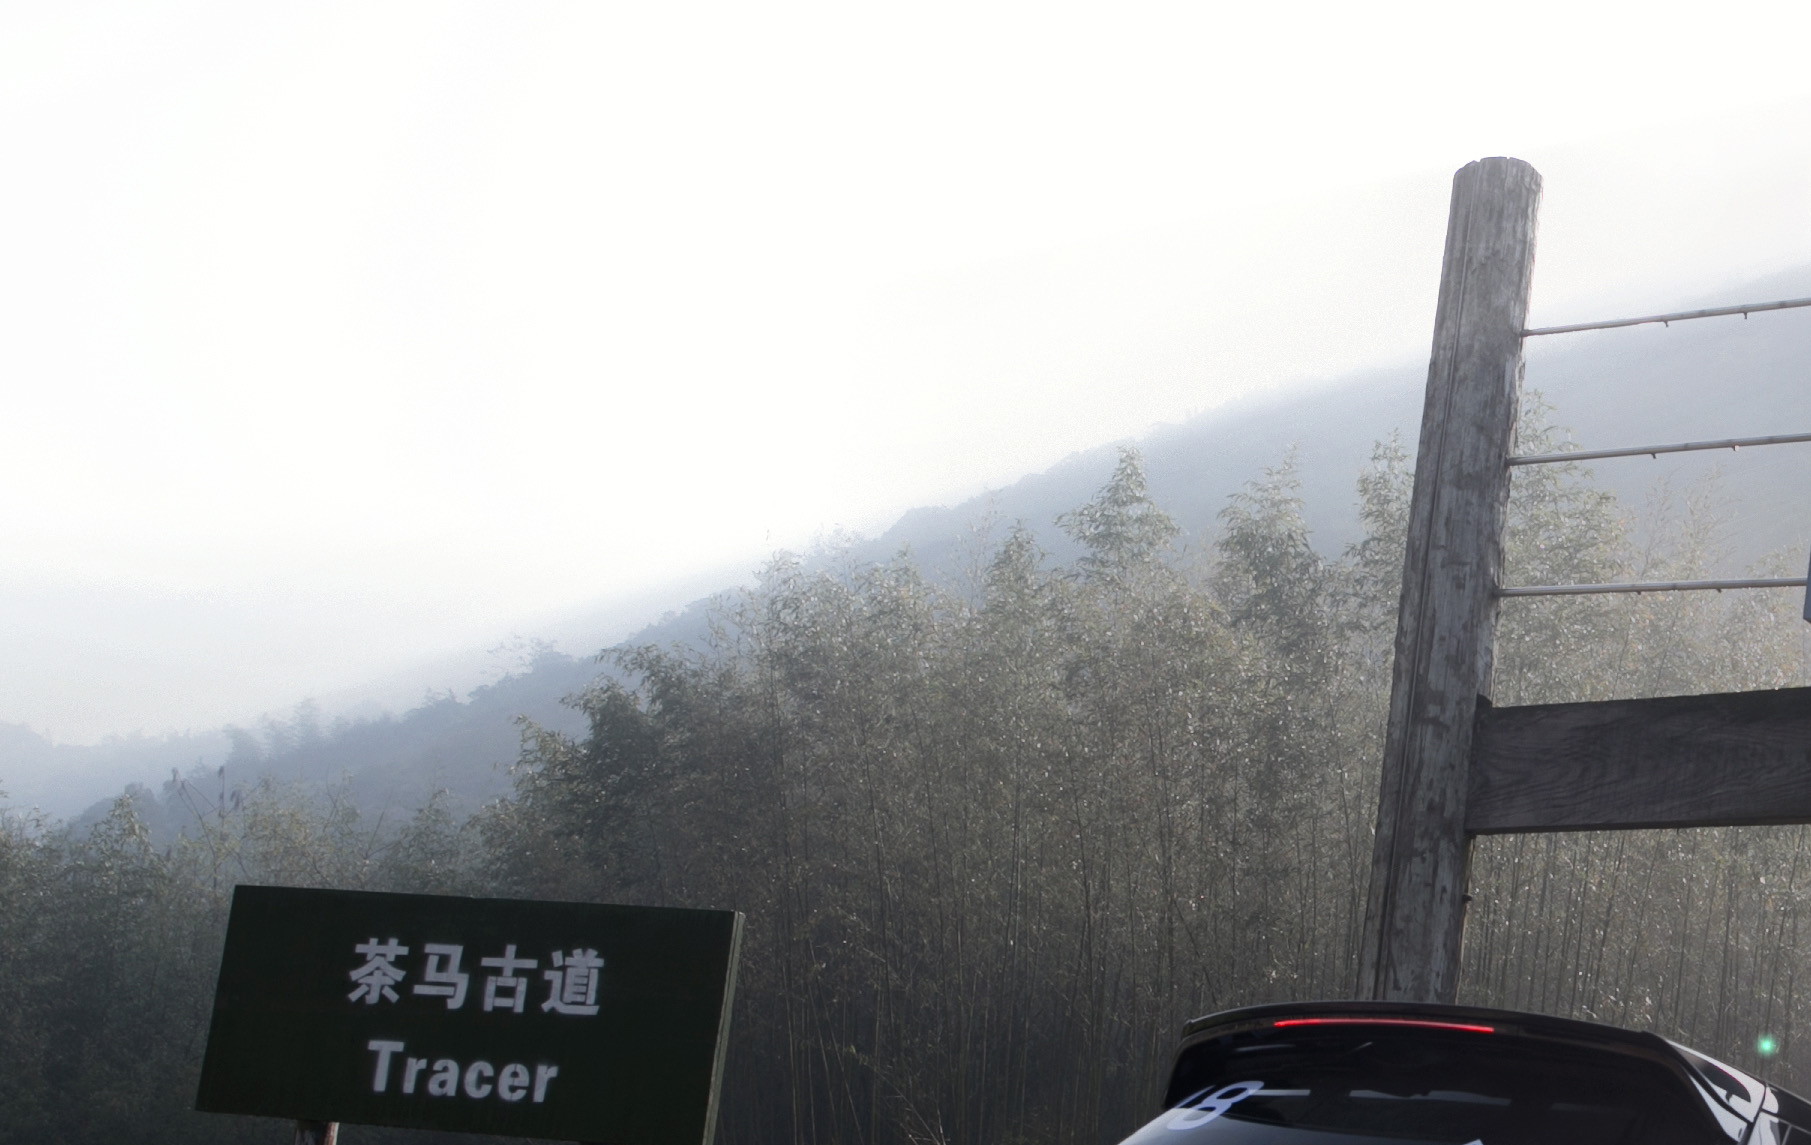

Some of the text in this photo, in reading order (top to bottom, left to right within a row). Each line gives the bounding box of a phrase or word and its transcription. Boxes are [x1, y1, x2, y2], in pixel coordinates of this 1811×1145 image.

[348, 937, 604, 1016] 茶马古道
[367, 1040, 558, 1102] Tracer
